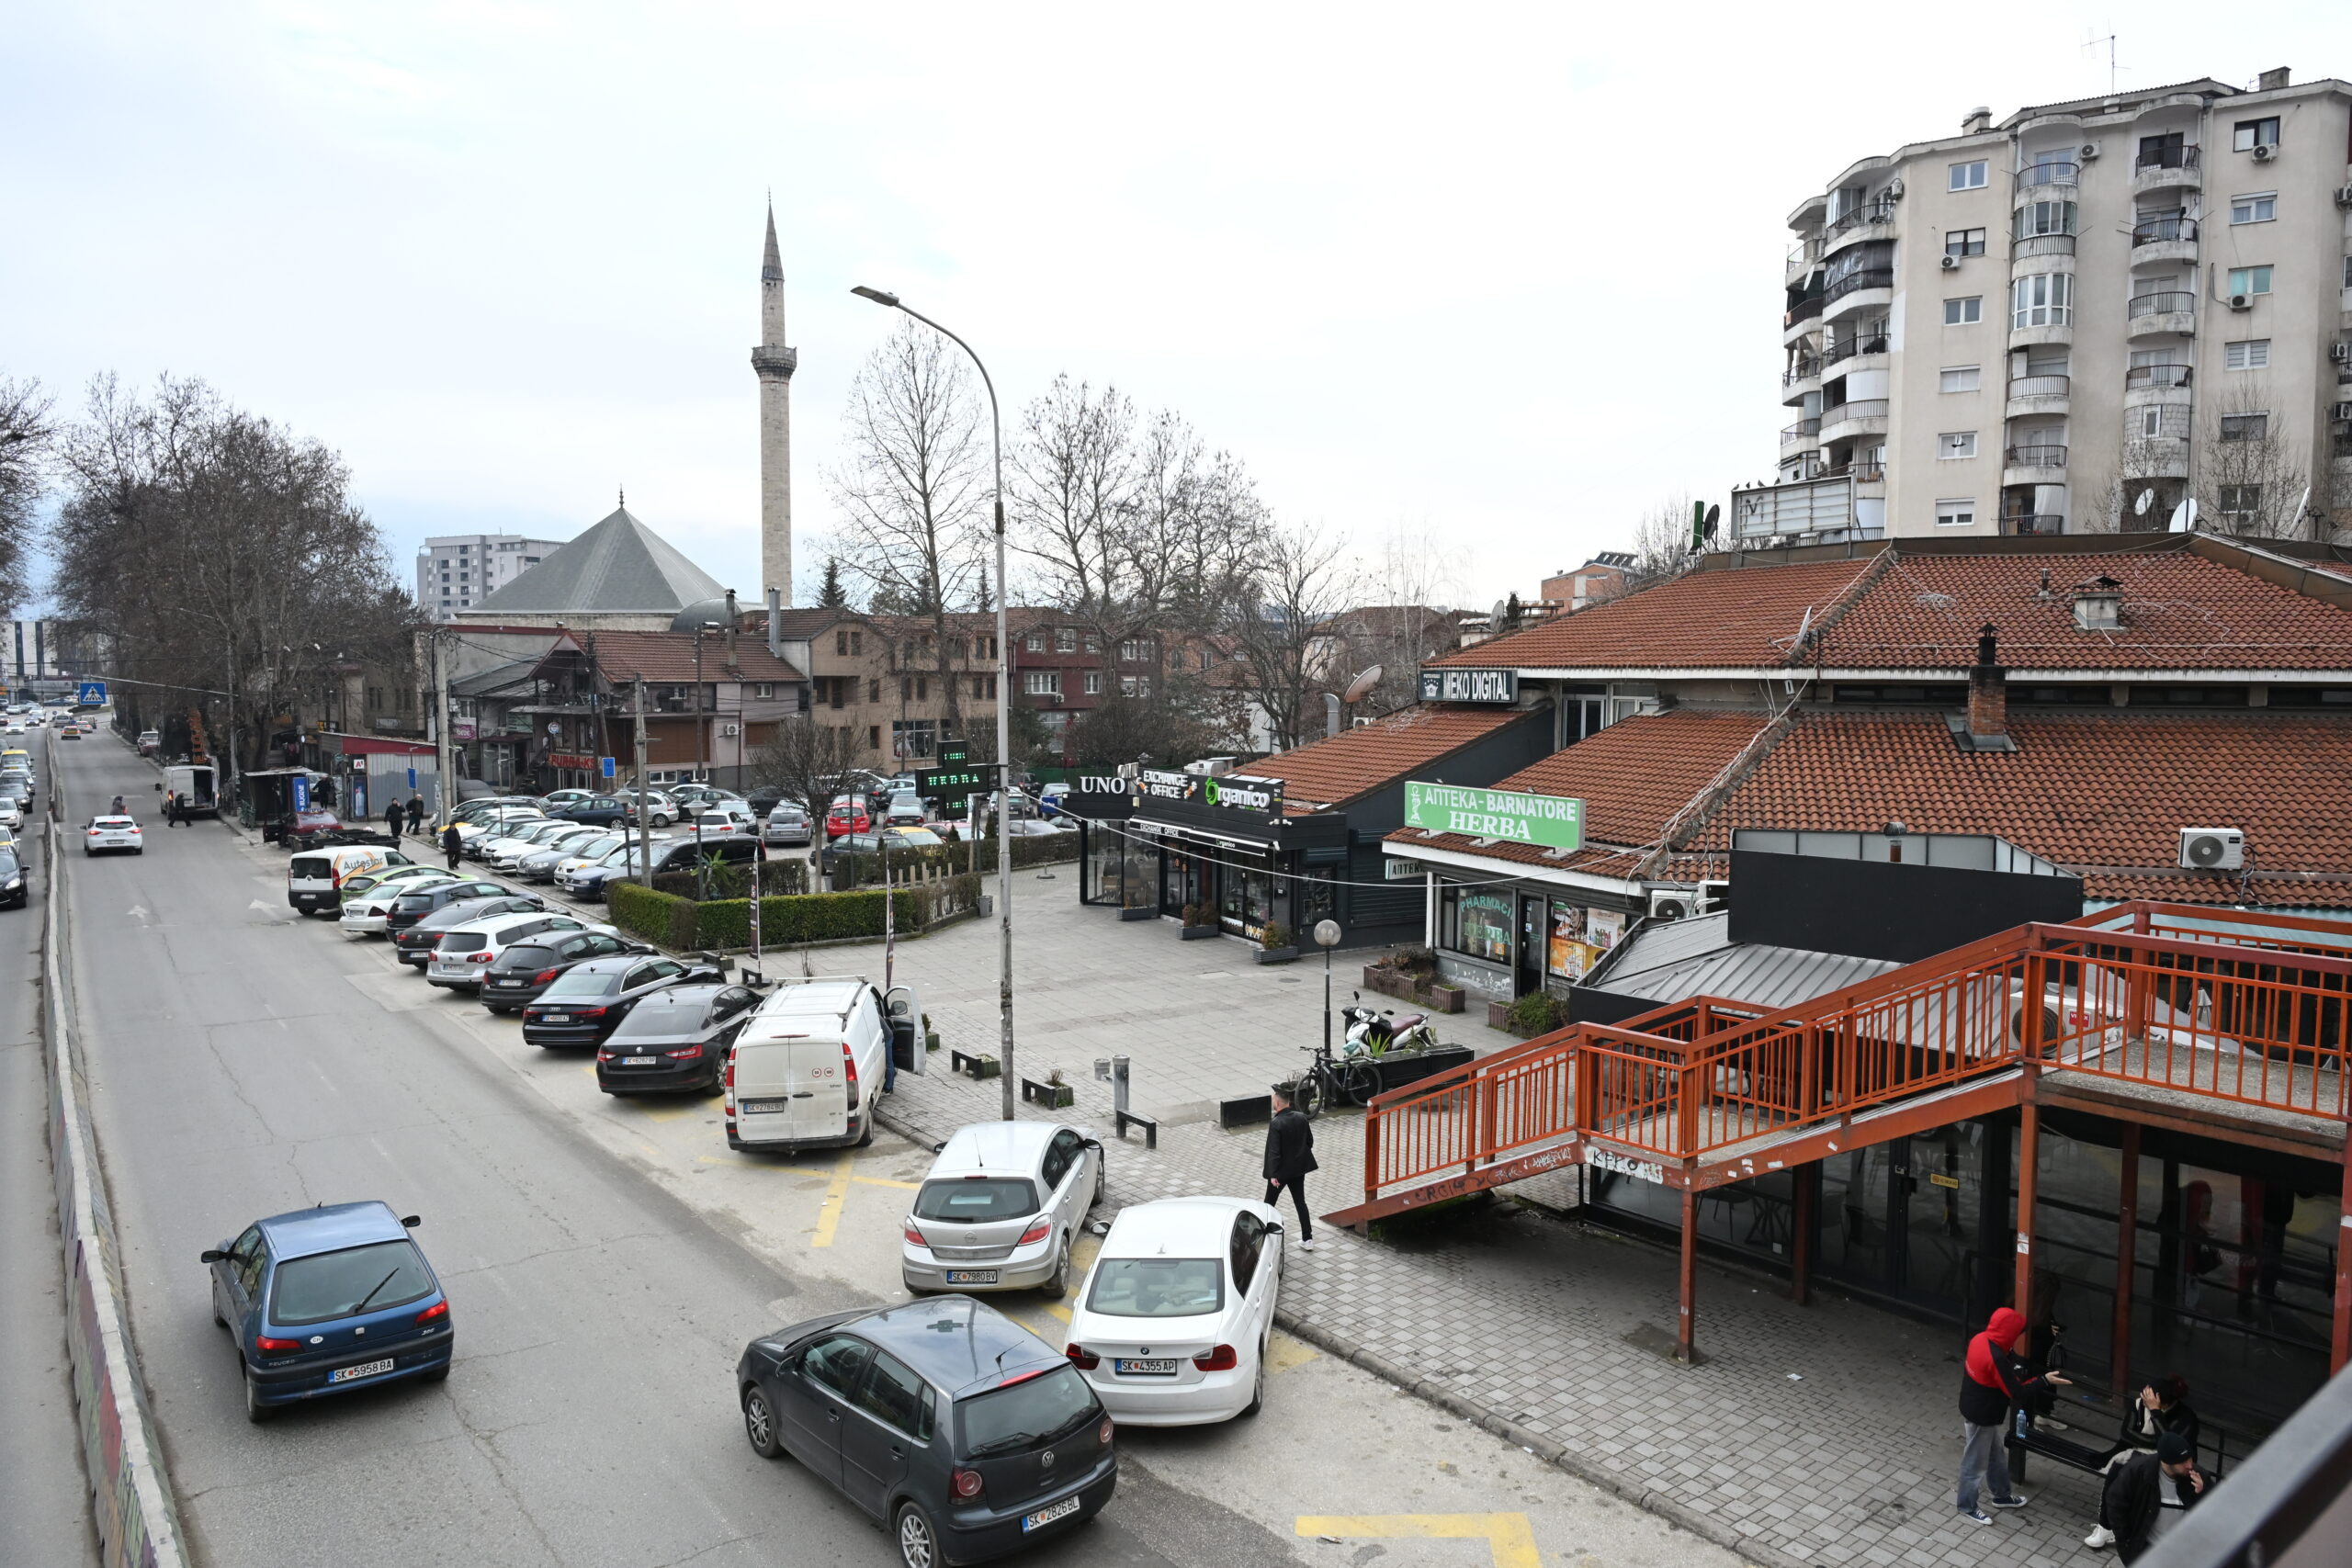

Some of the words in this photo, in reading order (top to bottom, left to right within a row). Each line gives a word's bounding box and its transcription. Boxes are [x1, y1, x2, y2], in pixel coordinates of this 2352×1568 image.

[1443, 671, 1469, 699] MEKO
[1472, 672, 1510, 700] DIGITAL
[1080, 776, 1125, 794] UNO
[1144, 771, 1188, 786] EXCHANGE
[1150, 784, 1181, 798] OFFICE
[1205, 777, 1270, 807] Organico
[1425, 787, 1478, 810] АПТЕКА
[1487, 794, 1577, 821] BARNATORE
[1140, 824, 1162, 834] EXCHANGE
[1164, 828, 1179, 837] OFFICE
[1448, 810, 1532, 840] HERBA
[344, 856, 383, 871] Autostar
[2070, 1012, 2088, 1021] VIX
[335, 1370, 347, 1381] SK
[354, 1363, 379, 1376] 5958
[379, 1360, 392, 1371] BA
[1123, 1361, 1133, 1371] SK
[1139, 1361, 1162, 1371] 4355
[1163, 1361, 1174, 1371] AP
[1029, 1513, 1040, 1527] SK
[1046, 1501, 1067, 1520] 2826
[1068, 1498, 1079, 1511] BL
